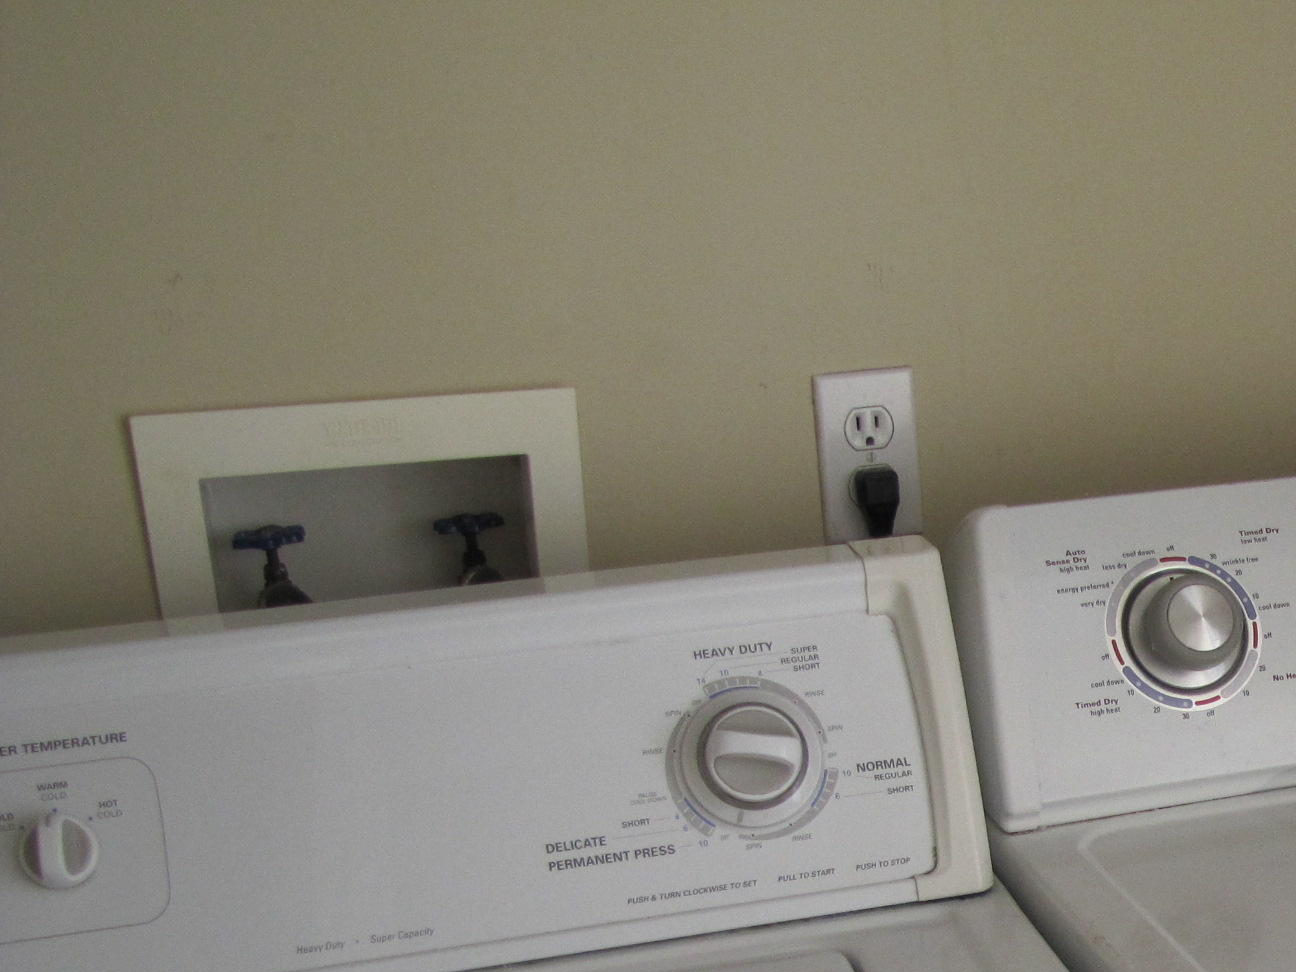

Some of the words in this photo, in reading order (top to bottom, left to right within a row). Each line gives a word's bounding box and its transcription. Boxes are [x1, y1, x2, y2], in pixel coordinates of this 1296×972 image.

[1239, 528, 1264, 537] Timed
[1265, 527, 1279, 535] Dry
[1065, 549, 1086, 558] Auto
[1122, 550, 1138, 559] cool
[1138, 548, 1156, 557] down
[1045, 558, 1072, 568] Sense
[1072, 556, 1088, 566] Dry
[1102, 563, 1117, 572] less
[1117, 562, 1128, 571] dry
[1221, 557, 1245, 566] wrinkle
[1246, 556, 1259, 564] free
[1060, 566, 1075, 575] high
[1075, 564, 1090, 573] heat
[1056, 586, 1080, 595] energy
[1080, 582, 1110, 593] preferred
[1080, 601, 1095, 609] very
[1095, 599, 1106, 608] dry
[1258, 603, 1273, 611] cool
[1273, 602, 1290, 610] down
[693, 646, 736, 660] HEAVY
[738, 641, 774, 656] DUTY
[790, 645, 819, 656] SUPER
[780, 653, 820, 666] REGULAR
[793, 663, 820, 673] SHORT
[1090, 680, 1106, 689] cool
[1106, 678, 1125, 687] down
[1272, 674, 1284, 682] No
[1075, 699, 1102, 710] Timed
[1103, 697, 1119, 707] Dry
[1090, 708, 1105, 718] high
[1105, 706, 1121, 715] heat
[1182, 712, 1190, 720] 30
[21, 730, 128, 755] TEMPERATURE
[856, 756, 911, 774] NORMAL
[873, 769, 913, 783] REGULAR
[36, 780, 69, 792] WARM
[886, 784, 914, 796] SHORT
[97, 799, 119, 810] HOT
[621, 817, 650, 829] SHORT
[545, 835, 608, 854] DELICATE
[547, 850, 631, 872] PERMANENT
[634, 844, 676, 862] PRESS
[856, 862, 877, 872] PUSH
[878, 860, 890, 869] TO
[890, 856, 911, 868] STOP
[777, 873, 797, 883] PULL
[799, 870, 811, 880] TO
[811, 867, 836, 878] START
[627, 895, 650, 905] PUSH
[659, 890, 682, 901] TURN
[683, 882, 728, 898] CLOCKWISE
[730, 880, 743, 890] TO
[743, 878, 759, 889] SET
[370, 932, 397, 945] Super
[397, 926, 434, 941] Capacity
[296, 943, 324, 955] Heavy
[325, 940, 346, 952] Duty
